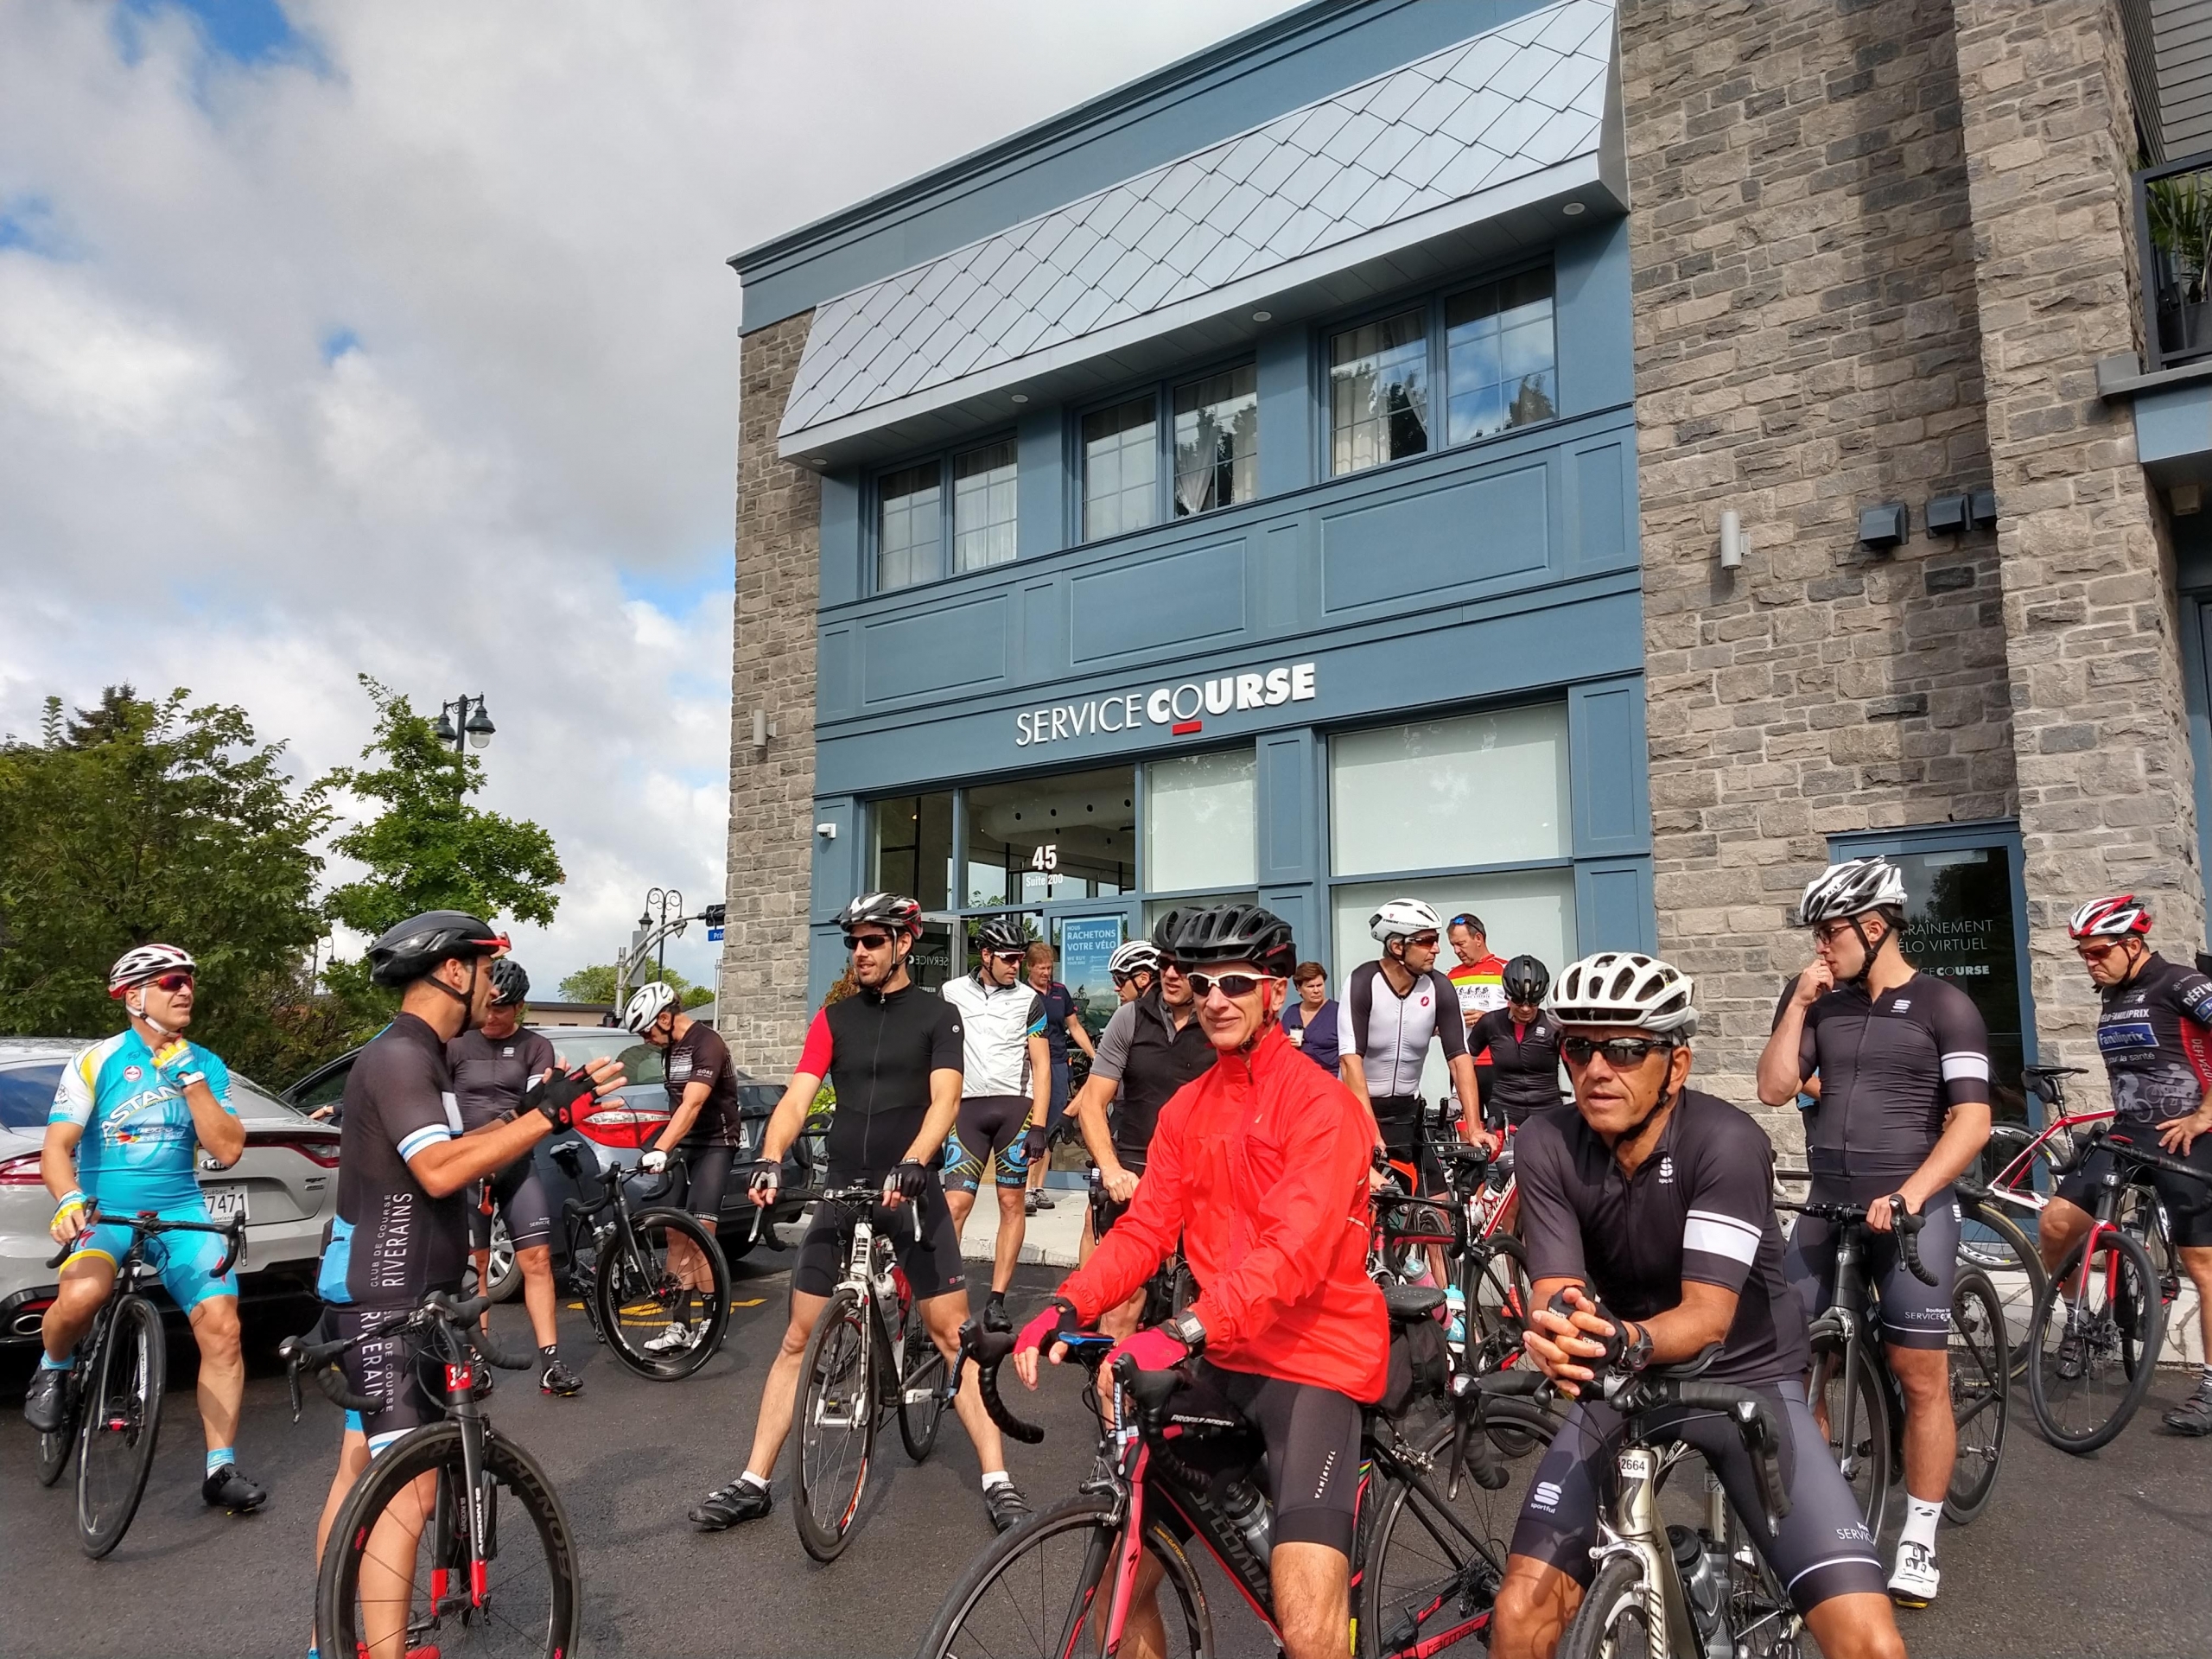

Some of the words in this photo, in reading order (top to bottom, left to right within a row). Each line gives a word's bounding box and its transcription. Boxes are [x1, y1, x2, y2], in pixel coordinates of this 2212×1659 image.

[1032, 844, 1058, 871] 45
[1026, 875, 1046, 887] Suite
[1047, 874, 1064, 886] 200
[1902, 919, 1993, 936] RAÎNEMENT
[1066, 929, 1116, 941] RACHETONS
[1066, 942, 1094, 951] VOTRE
[1095, 939, 1116, 950] VÉLO
[1929, 938, 1987, 951] VIRTUEL
[378, 1194, 391, 1238] COURSE
[382, 1192, 413, 1287] RIVERAINS
[373, 1243, 383, 1257] DE
[370, 1262, 379, 1287] CLUB
[385, 1363, 394, 1413] COURSE
[1621, 1459, 1645, 1471] 2664
[1530, 1502, 1556, 1515] sportful
